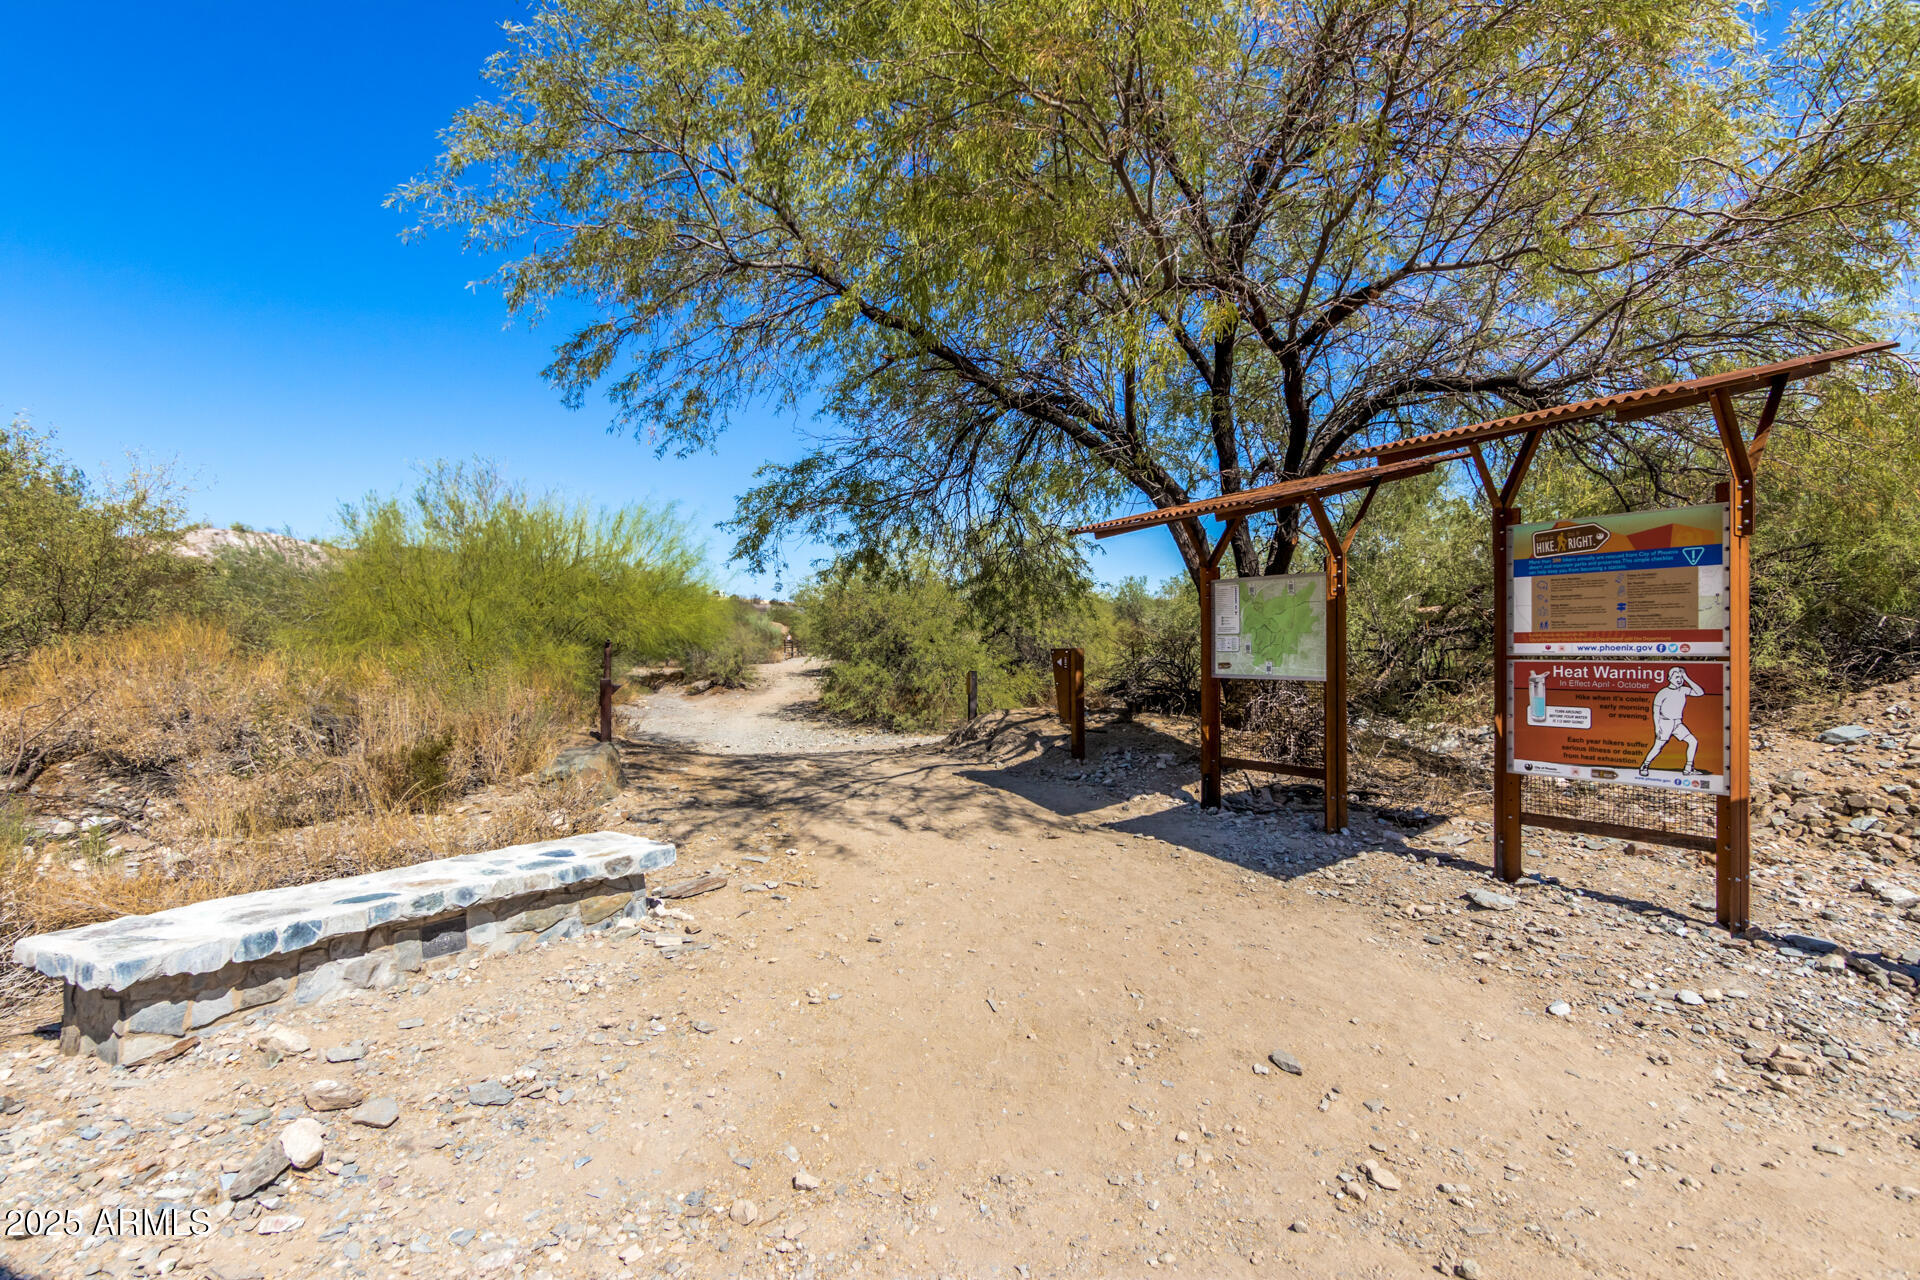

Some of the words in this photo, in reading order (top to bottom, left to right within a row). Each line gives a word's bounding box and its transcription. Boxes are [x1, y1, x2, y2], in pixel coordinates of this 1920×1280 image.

[1536, 540, 1557, 554] HIKE.
[1568, 535, 1596, 549] RIGHT.
[1577, 644, 1652, 652] www.phoenix.gov
[1552, 665, 1588, 678] Heat
[1593, 666, 1664, 683] Warning
[1617, 681, 1650, 689] October
[1597, 756, 1639, 764] exhaustion.
